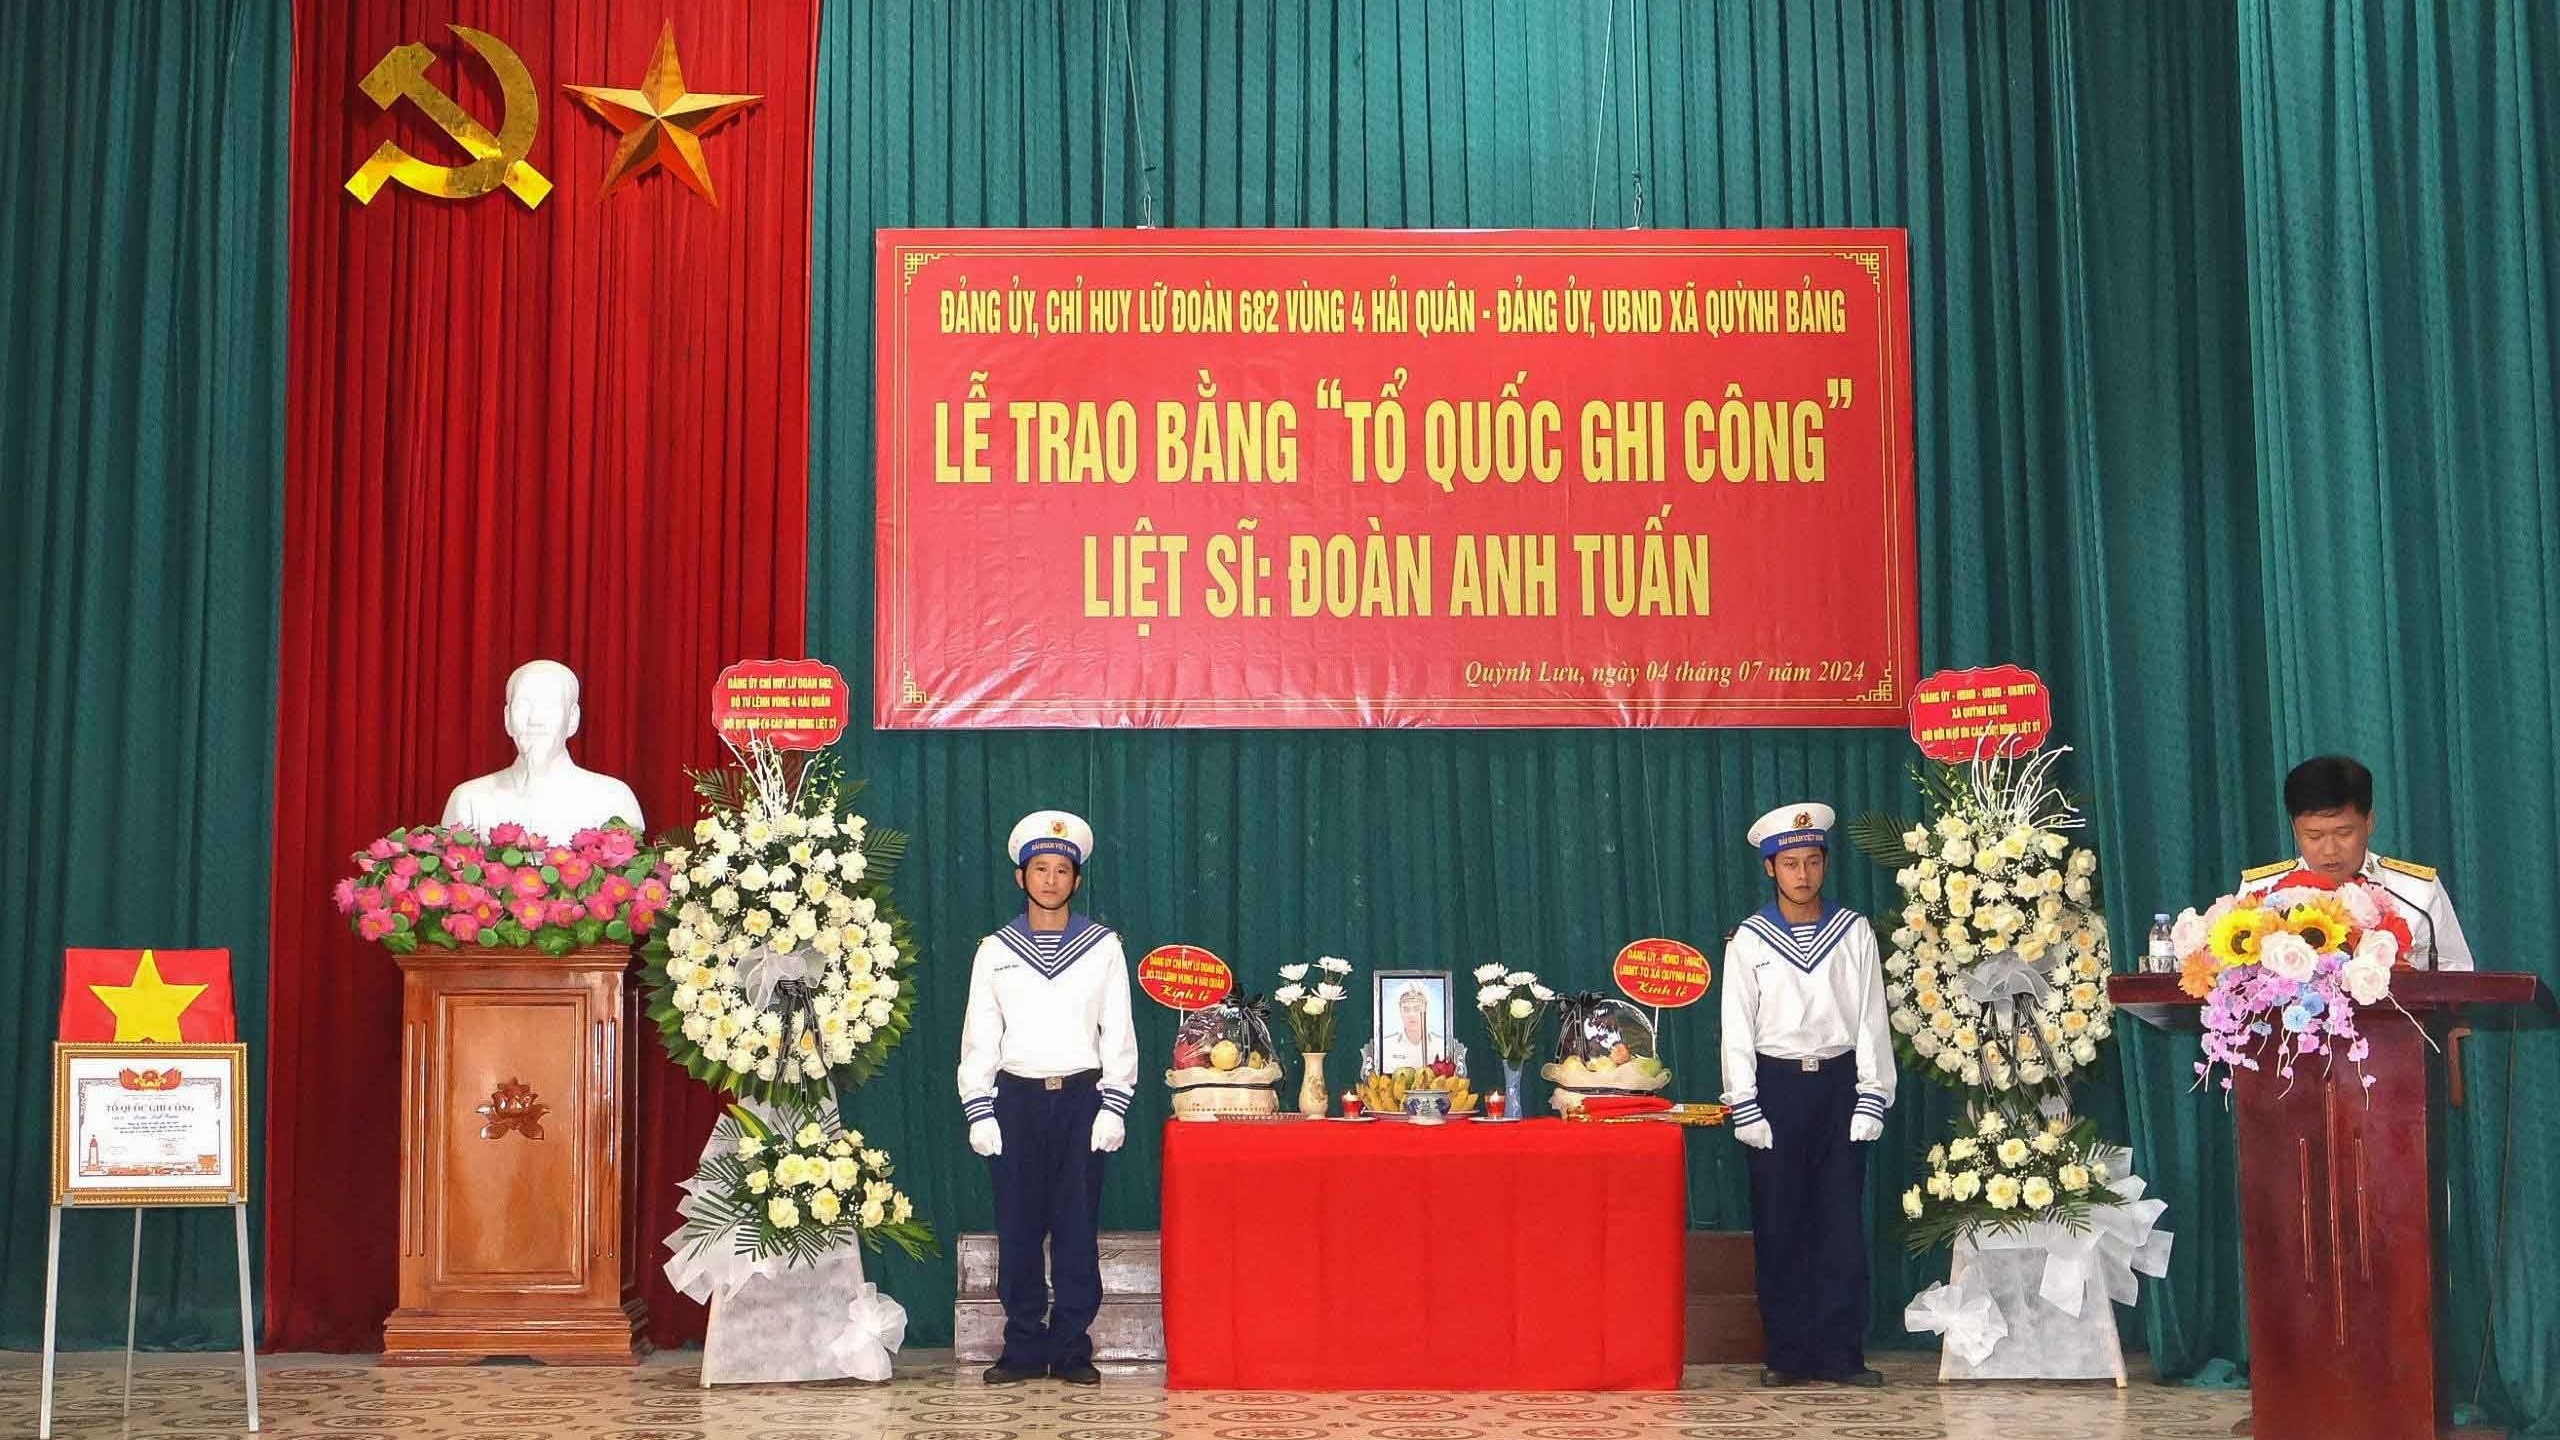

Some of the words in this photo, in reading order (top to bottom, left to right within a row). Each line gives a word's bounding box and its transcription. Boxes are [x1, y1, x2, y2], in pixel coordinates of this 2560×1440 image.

[939, 275, 1001, 335] ĐẢNG
[1007, 275, 1040, 339] ỦY,
[1045, 275, 1084, 335] CHỈ
[1089, 289, 1132, 334] HUY
[1138, 281, 1170, 334] LỮ
[1171, 280, 1233, 335] ĐOÀN
[1239, 289, 1280, 334] 682
[1285, 280, 1345, 334] VÙNG
[1351, 290, 1366, 333] 4
[1371, 274, 1409, 334] HẢI
[1414, 280, 1476, 338] QUÂN
[1496, 275, 1558, 334] ĐẢNG
[1564, 275, 1596, 338] ỦY,
[1601, 289, 1663, 334] UBND
[1668, 281, 1700, 333] XÃ
[1705, 281, 1779, 338] QUỲNH
[1785, 275, 1846, 334] BẢNG
[934, 370, 993, 484] LỄ
[1008, 400, 1139, 484] TRAO
[1156, 369, 1299, 484] BẰNG
[1424, 370, 1563, 493] QUỐC
[1580, 399, 1666, 484] GHI
[1083, 516, 1189, 637] LIỆT
[1205, 517, 1273, 619] SĨ:
[1287, 516, 1433, 619] ĐOÀN
[1448, 534, 1558, 618] ANH
[1573, 503, 1711, 618] TUẤN
[1464, 661, 1531, 687] Quỳnh
[1538, 661, 1585, 686] Lưu,
[1591, 665, 1640, 687] ngày
[1645, 661, 1669, 682] 04
[1674, 661, 1731, 687] tháng
[1738, 660, 1763, 681] 07
[1767, 662, 1812, 682] năm
[1817, 659, 1866, 681] 2024
[1637, 981, 1671, 995] Kính
